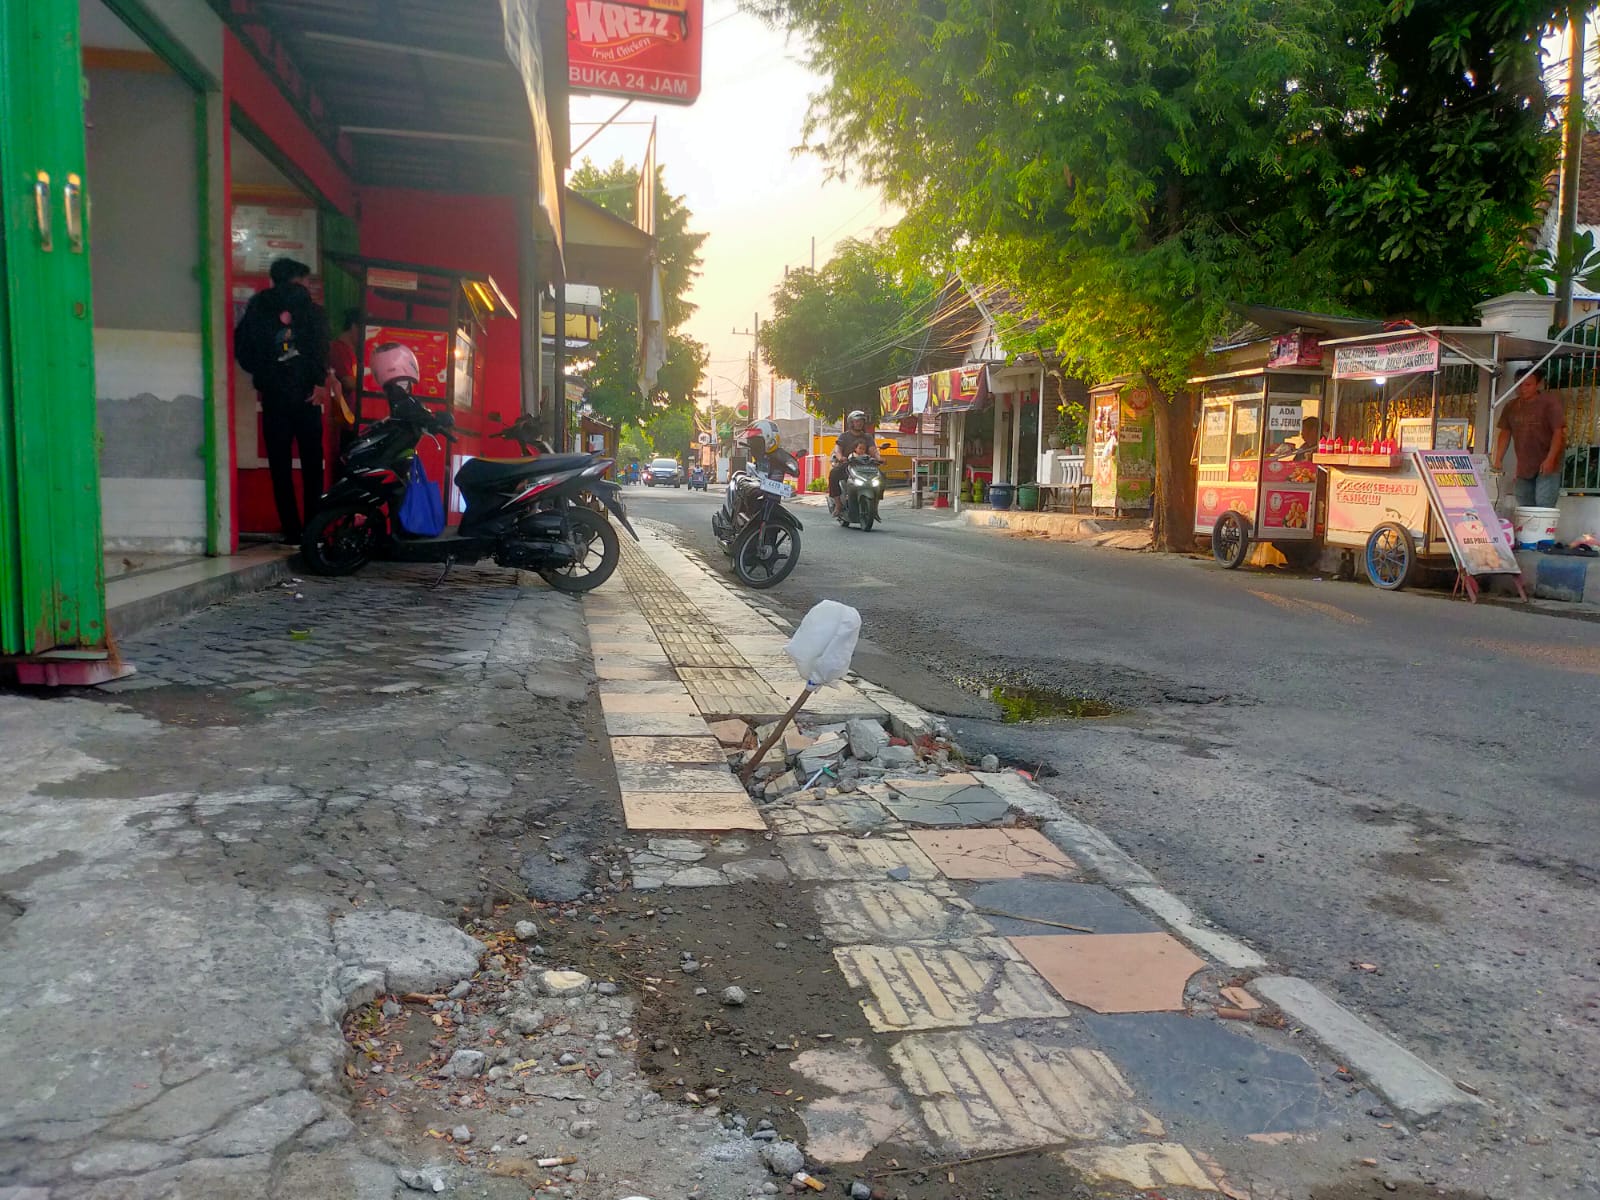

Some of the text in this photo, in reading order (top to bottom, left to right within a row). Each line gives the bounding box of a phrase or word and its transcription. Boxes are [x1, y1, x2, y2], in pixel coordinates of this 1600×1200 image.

[576, 1, 669, 43] KREZZ
[592, 37, 651, 60] Fried Chicken
[568, 66, 687, 95] BUKA 24 JAM
[1414, 352, 1435, 367] GORENG
[1271, 417, 1301, 427] ES JERUK
[1424, 455, 1473, 470] CILOK SEHATI
[1373, 482, 1418, 496] SEHATI
